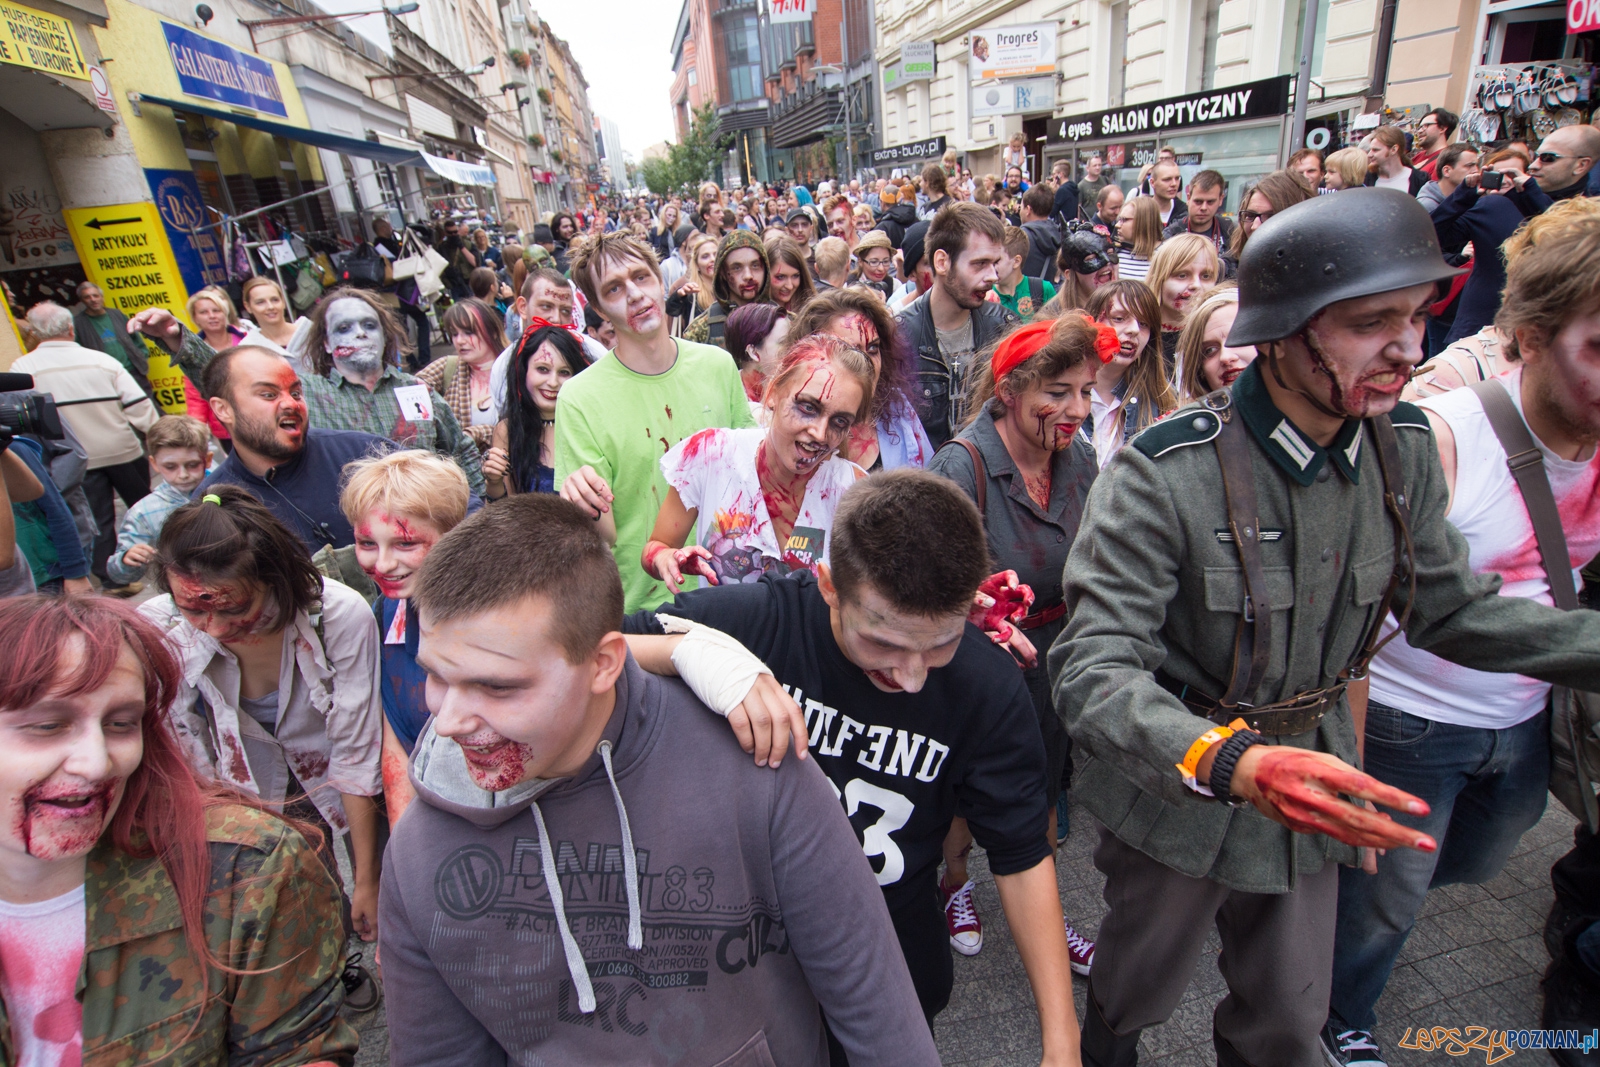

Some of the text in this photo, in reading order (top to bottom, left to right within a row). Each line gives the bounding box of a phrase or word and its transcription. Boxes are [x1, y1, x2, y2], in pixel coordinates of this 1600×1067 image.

[0, 6, 65, 34] HURT-DETAL
[7, 21, 70, 54] PAPIERNICZE
[15, 43, 24, 62] I
[27, 46, 76, 74] BIUROWE
[170, 41, 244, 91] GALANTERIA
[904, 62, 933, 73] GEERS
[1059, 89, 1252, 141] 4 eyes SALON OPTYCZNY
[91, 233, 148, 251] ARTYKUŁY
[97, 253, 157, 271] PAPIERNICZE
[105, 272, 164, 290] SZKOLNE
[118, 291, 170, 309] BIUROWE
[652, 927, 713, 941] DIVISION
[648, 957, 708, 970] APPROVED
